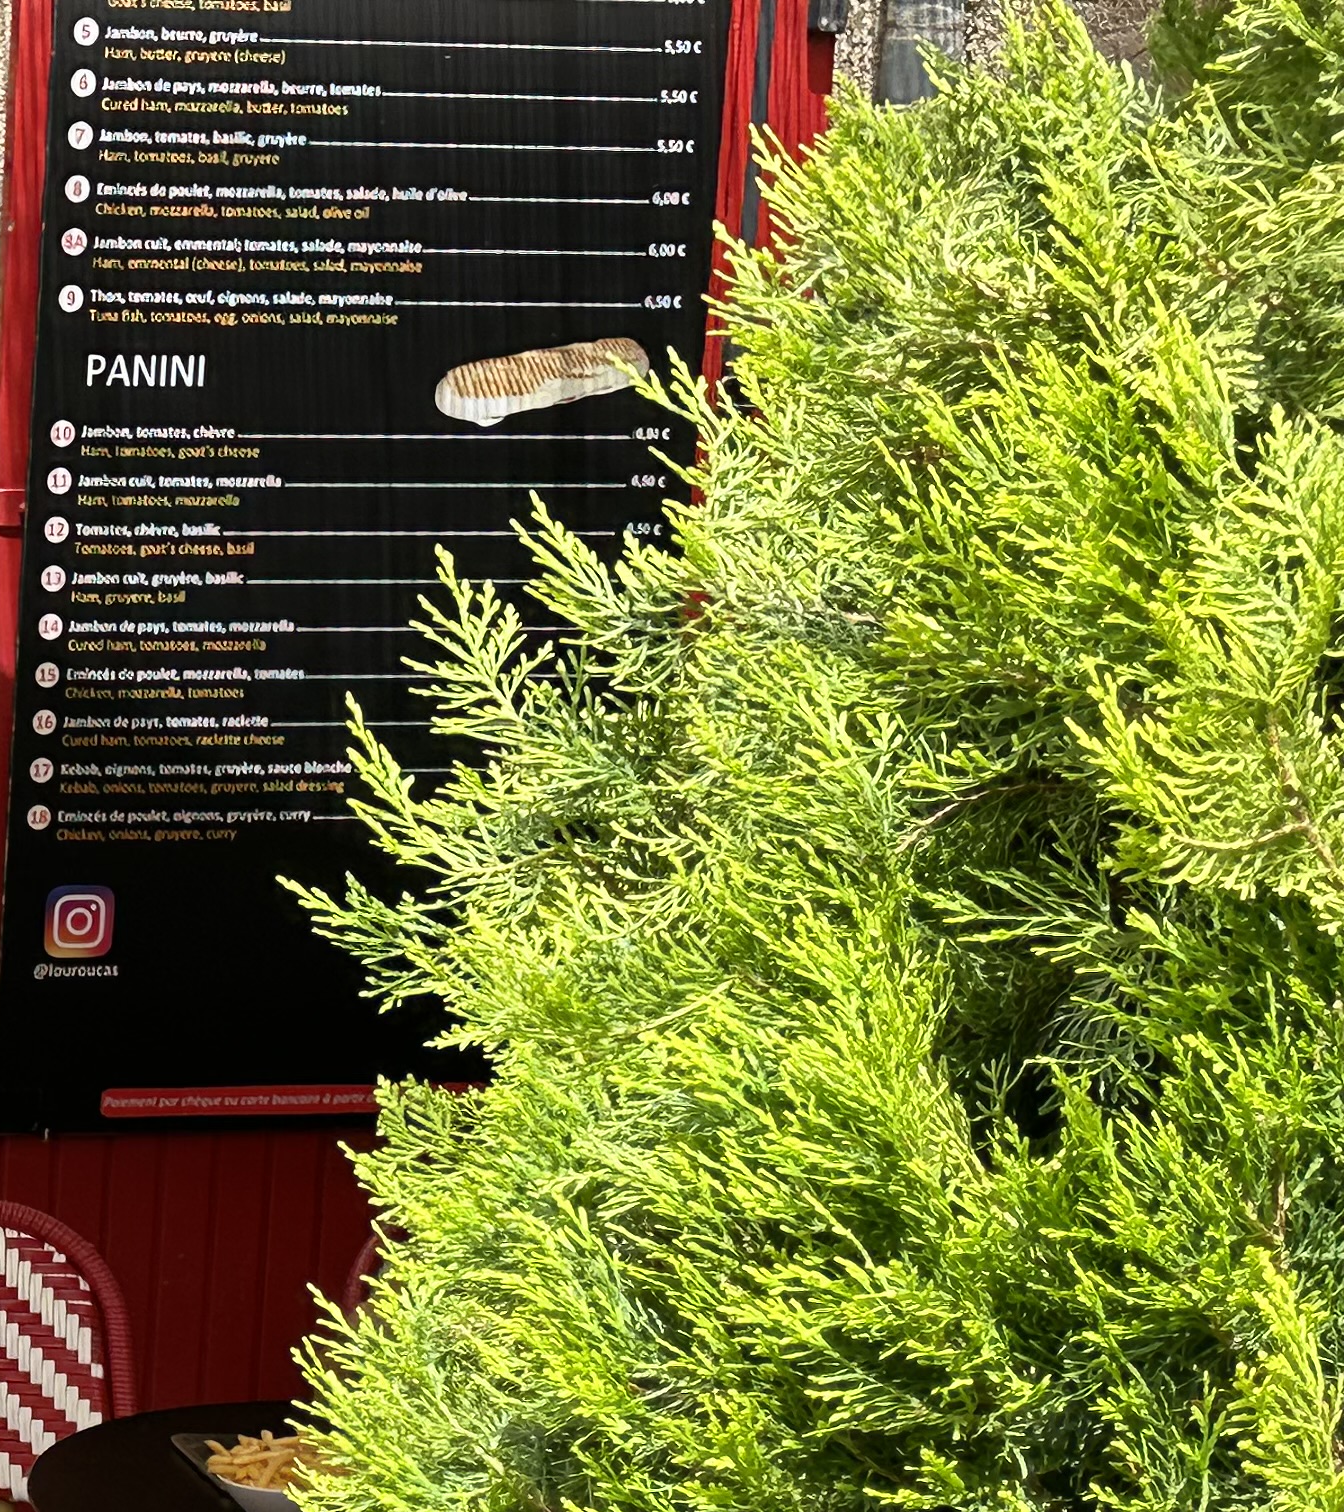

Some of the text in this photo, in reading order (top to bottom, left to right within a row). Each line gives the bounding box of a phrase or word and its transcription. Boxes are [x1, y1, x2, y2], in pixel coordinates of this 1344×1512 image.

[82, 24, 90, 39] 5
[80, 77, 88, 90] 6
[76, 128, 85, 144] 7
[73, 181, 82, 197] 8
[67, 291, 75, 306] 9
[87, 354, 205, 387] PANINI
[54, 427, 71, 440] 10
[52, 475, 68, 487] 11
[48, 523, 65, 536] 12
[44, 620, 58, 634] 14
[40, 669, 56, 682] 15
[37, 715, 53, 729] 16
[34, 763, 50, 777] 17
[31, 810, 48, 824] 18
[34, 964, 118, 979] @louroucas
